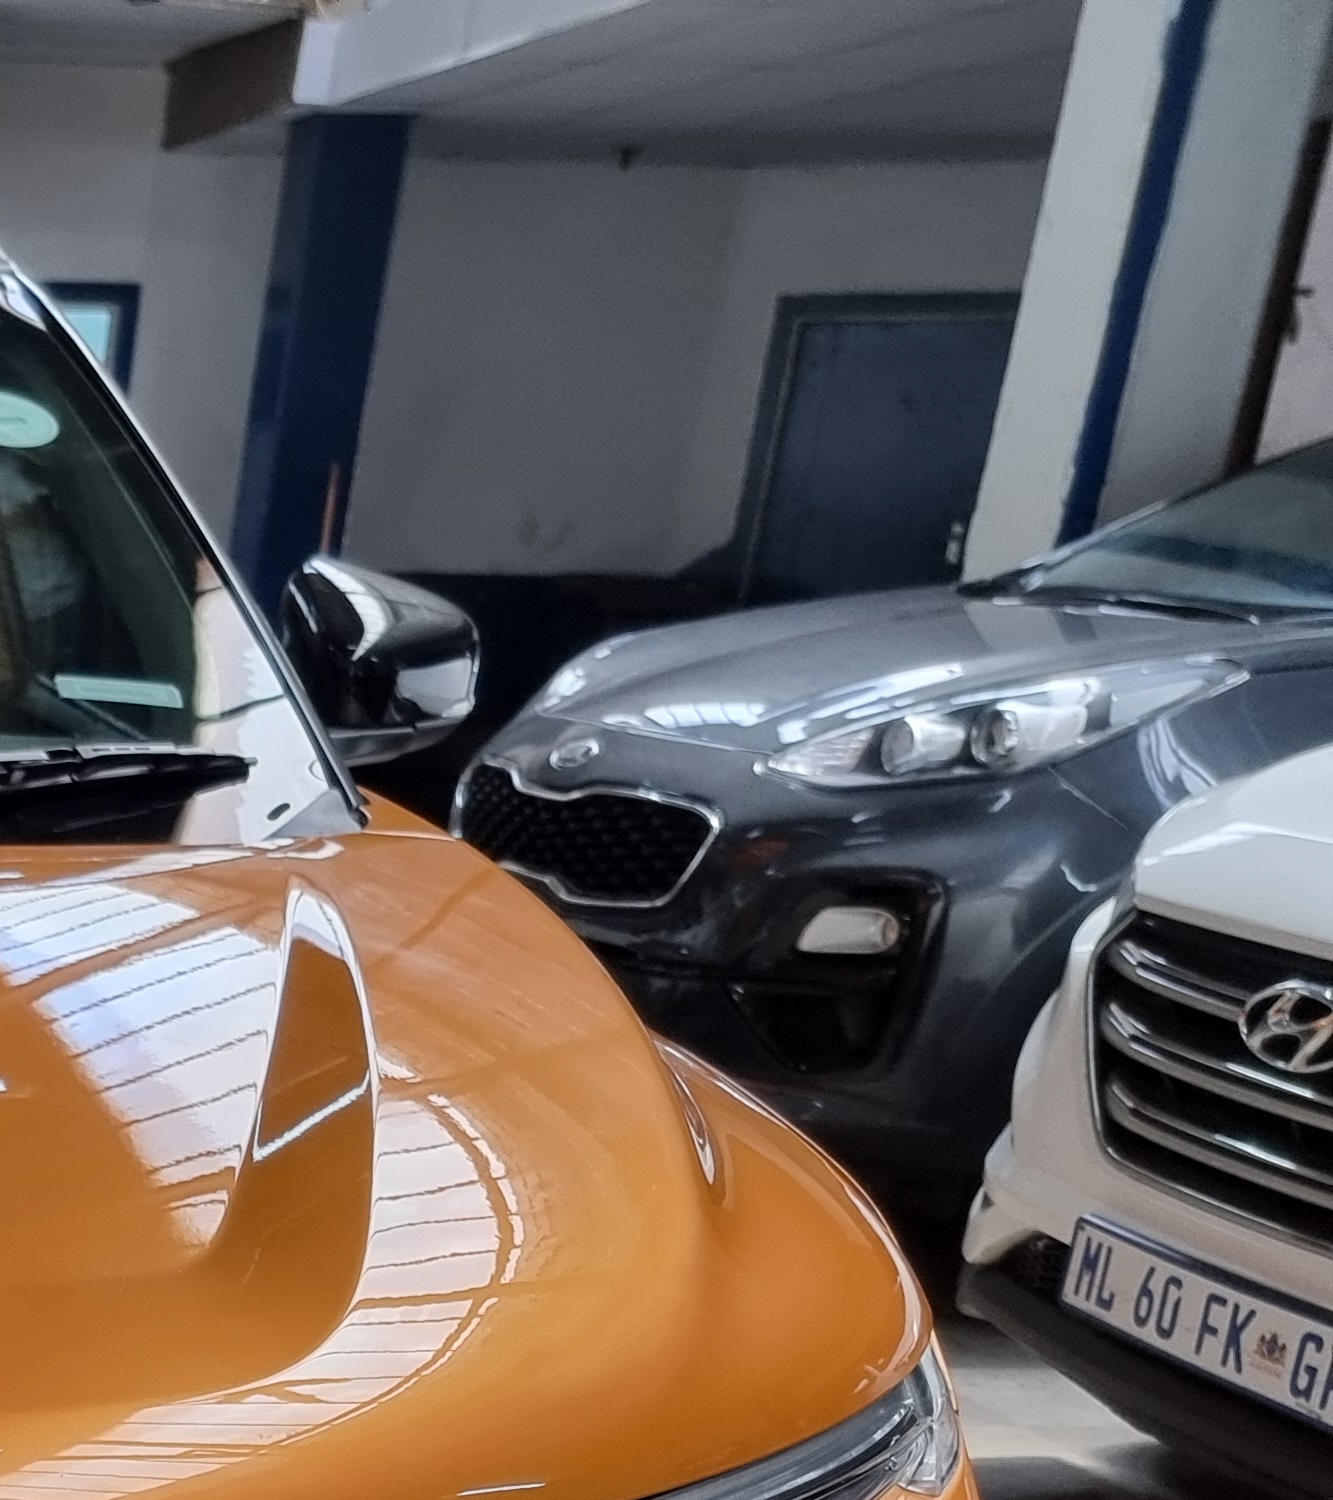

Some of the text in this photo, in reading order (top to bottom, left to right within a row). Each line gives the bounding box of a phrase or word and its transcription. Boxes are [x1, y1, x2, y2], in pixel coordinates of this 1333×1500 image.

[1073, 1235, 1116, 1313] ML
[1132, 1266, 1183, 1341] 60
[1193, 1292, 1258, 1376] FK
